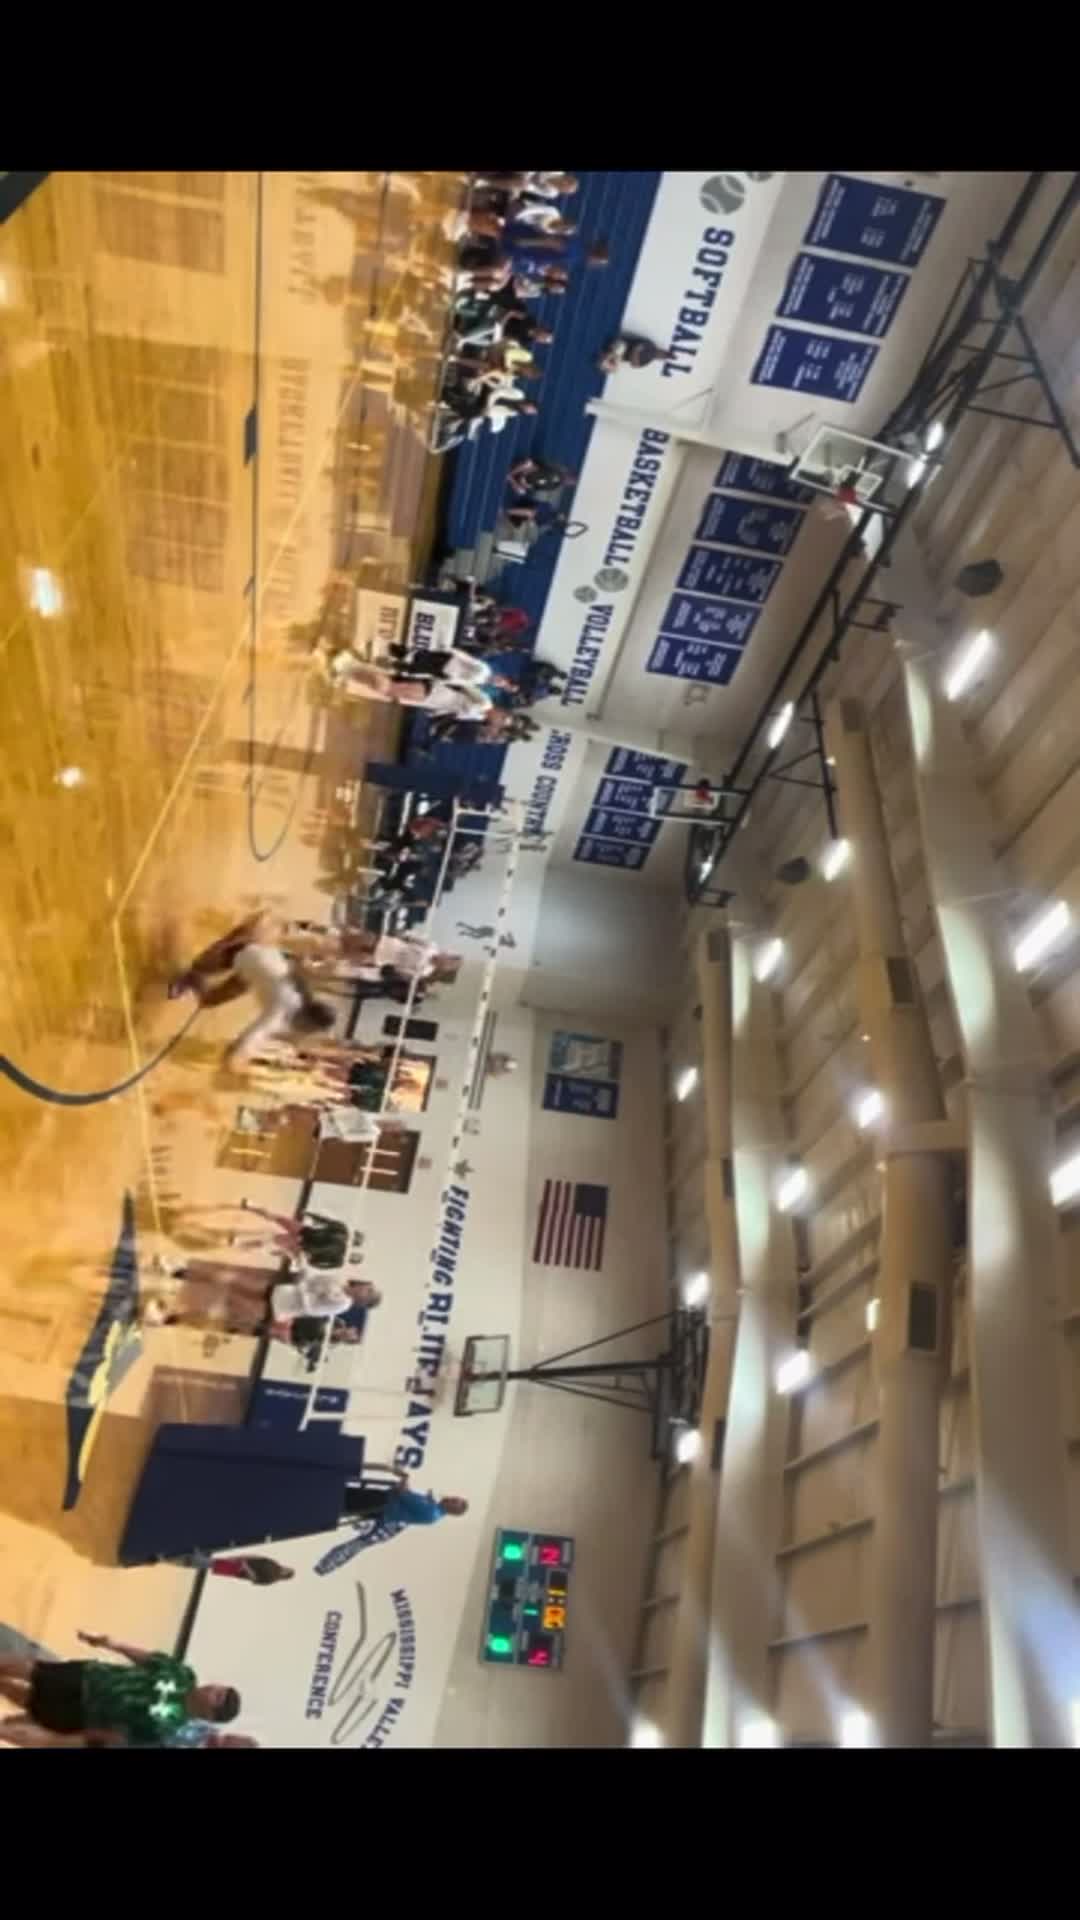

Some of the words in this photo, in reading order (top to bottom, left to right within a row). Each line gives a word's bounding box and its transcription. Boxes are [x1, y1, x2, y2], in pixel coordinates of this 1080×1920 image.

[660, 227, 734, 377] SOFTBALL
[602, 428, 672, 566] BASKETBALL
[411, 612, 436, 654] BLU
[560, 604, 613, 708] VOLLEYBALL
[432, 1185, 470, 1288] FIGHTING
[306, 1610, 342, 1720] CONFERENCE
[391, 1588, 416, 1690] MISSISSIPPI
[360, 1697, 405, 1749] VALLE
